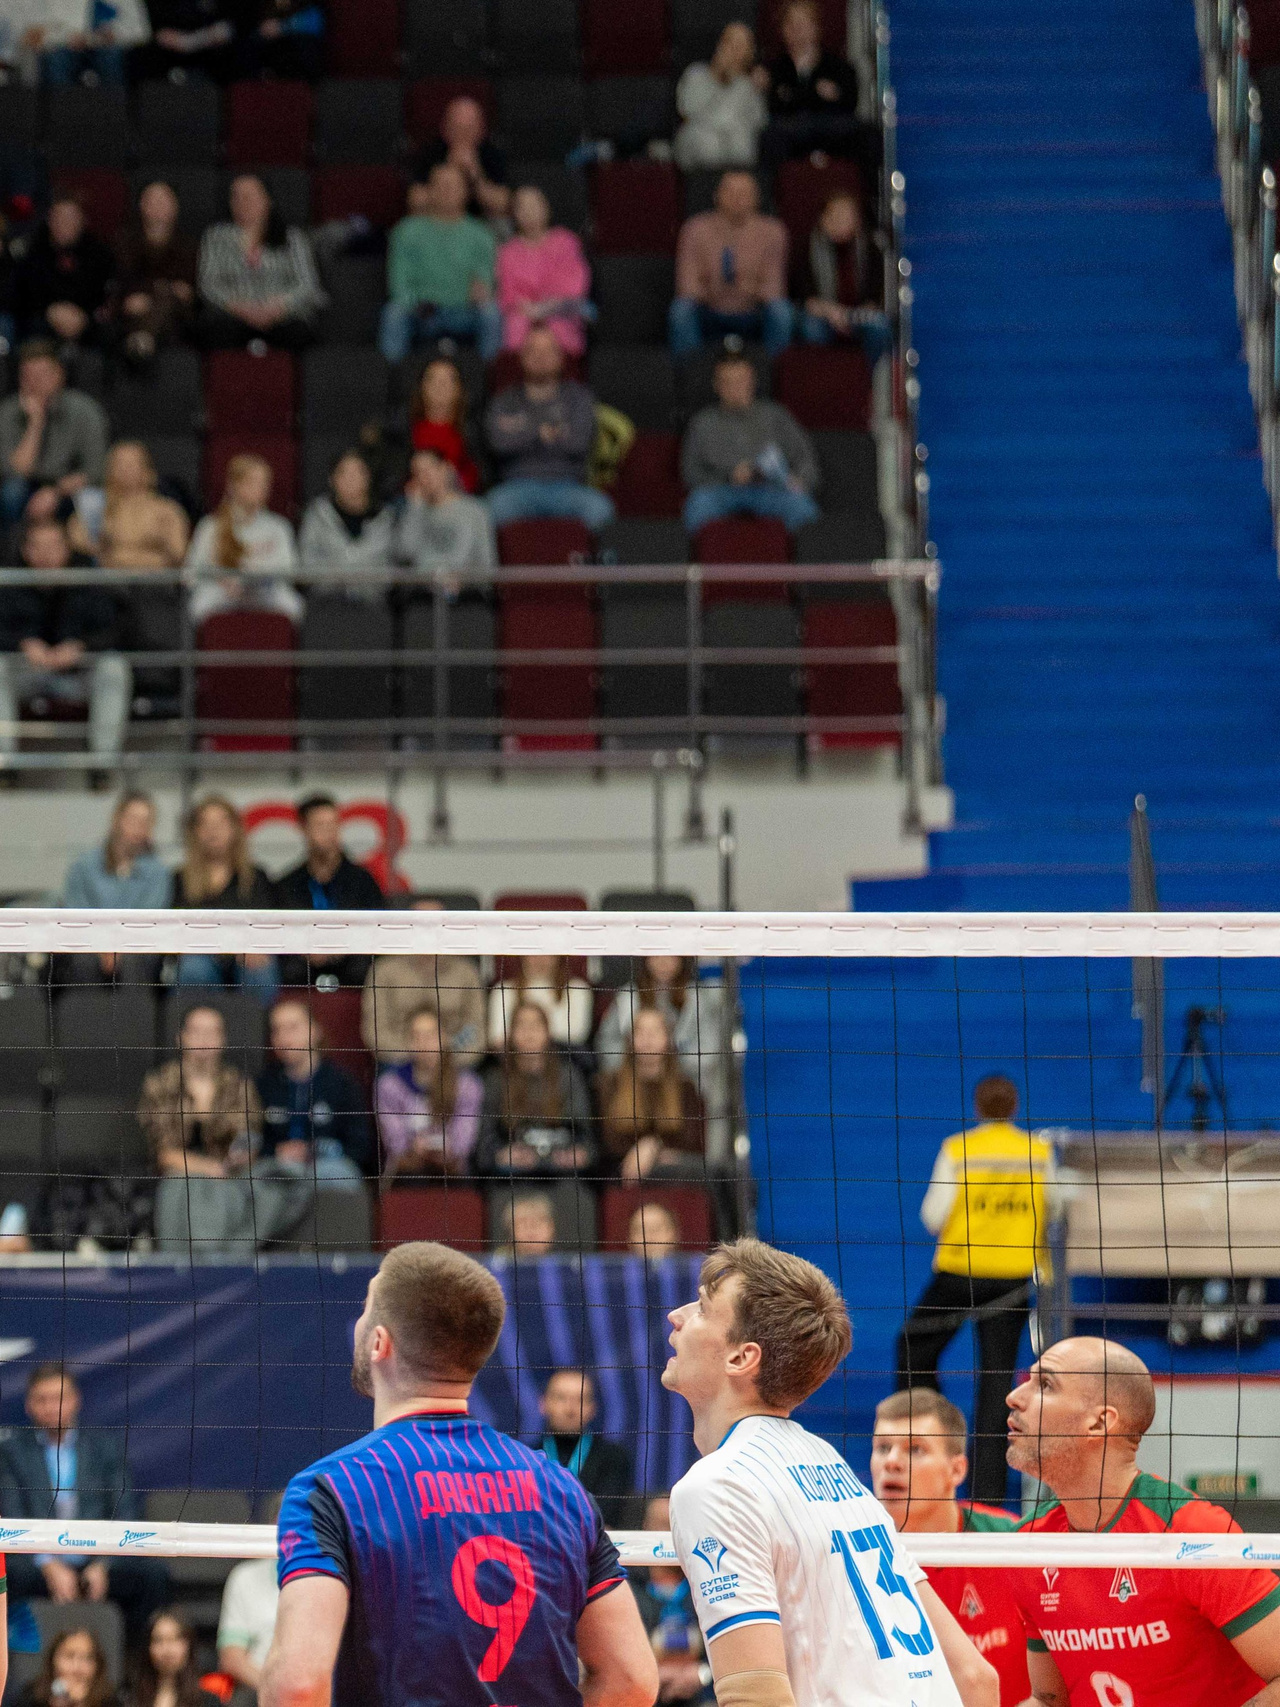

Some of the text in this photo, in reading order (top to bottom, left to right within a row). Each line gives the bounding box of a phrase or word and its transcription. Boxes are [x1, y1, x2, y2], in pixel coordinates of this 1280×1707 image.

[414, 1470, 542, 1519] ДАНАНИ
[700, 1573, 739, 1590] СУПЕР
[701, 1581, 740, 1598] КУБОК
[708, 1591, 737, 1605] 2025
[830, 1524, 935, 1660] 13
[451, 1535, 536, 1682] 9
